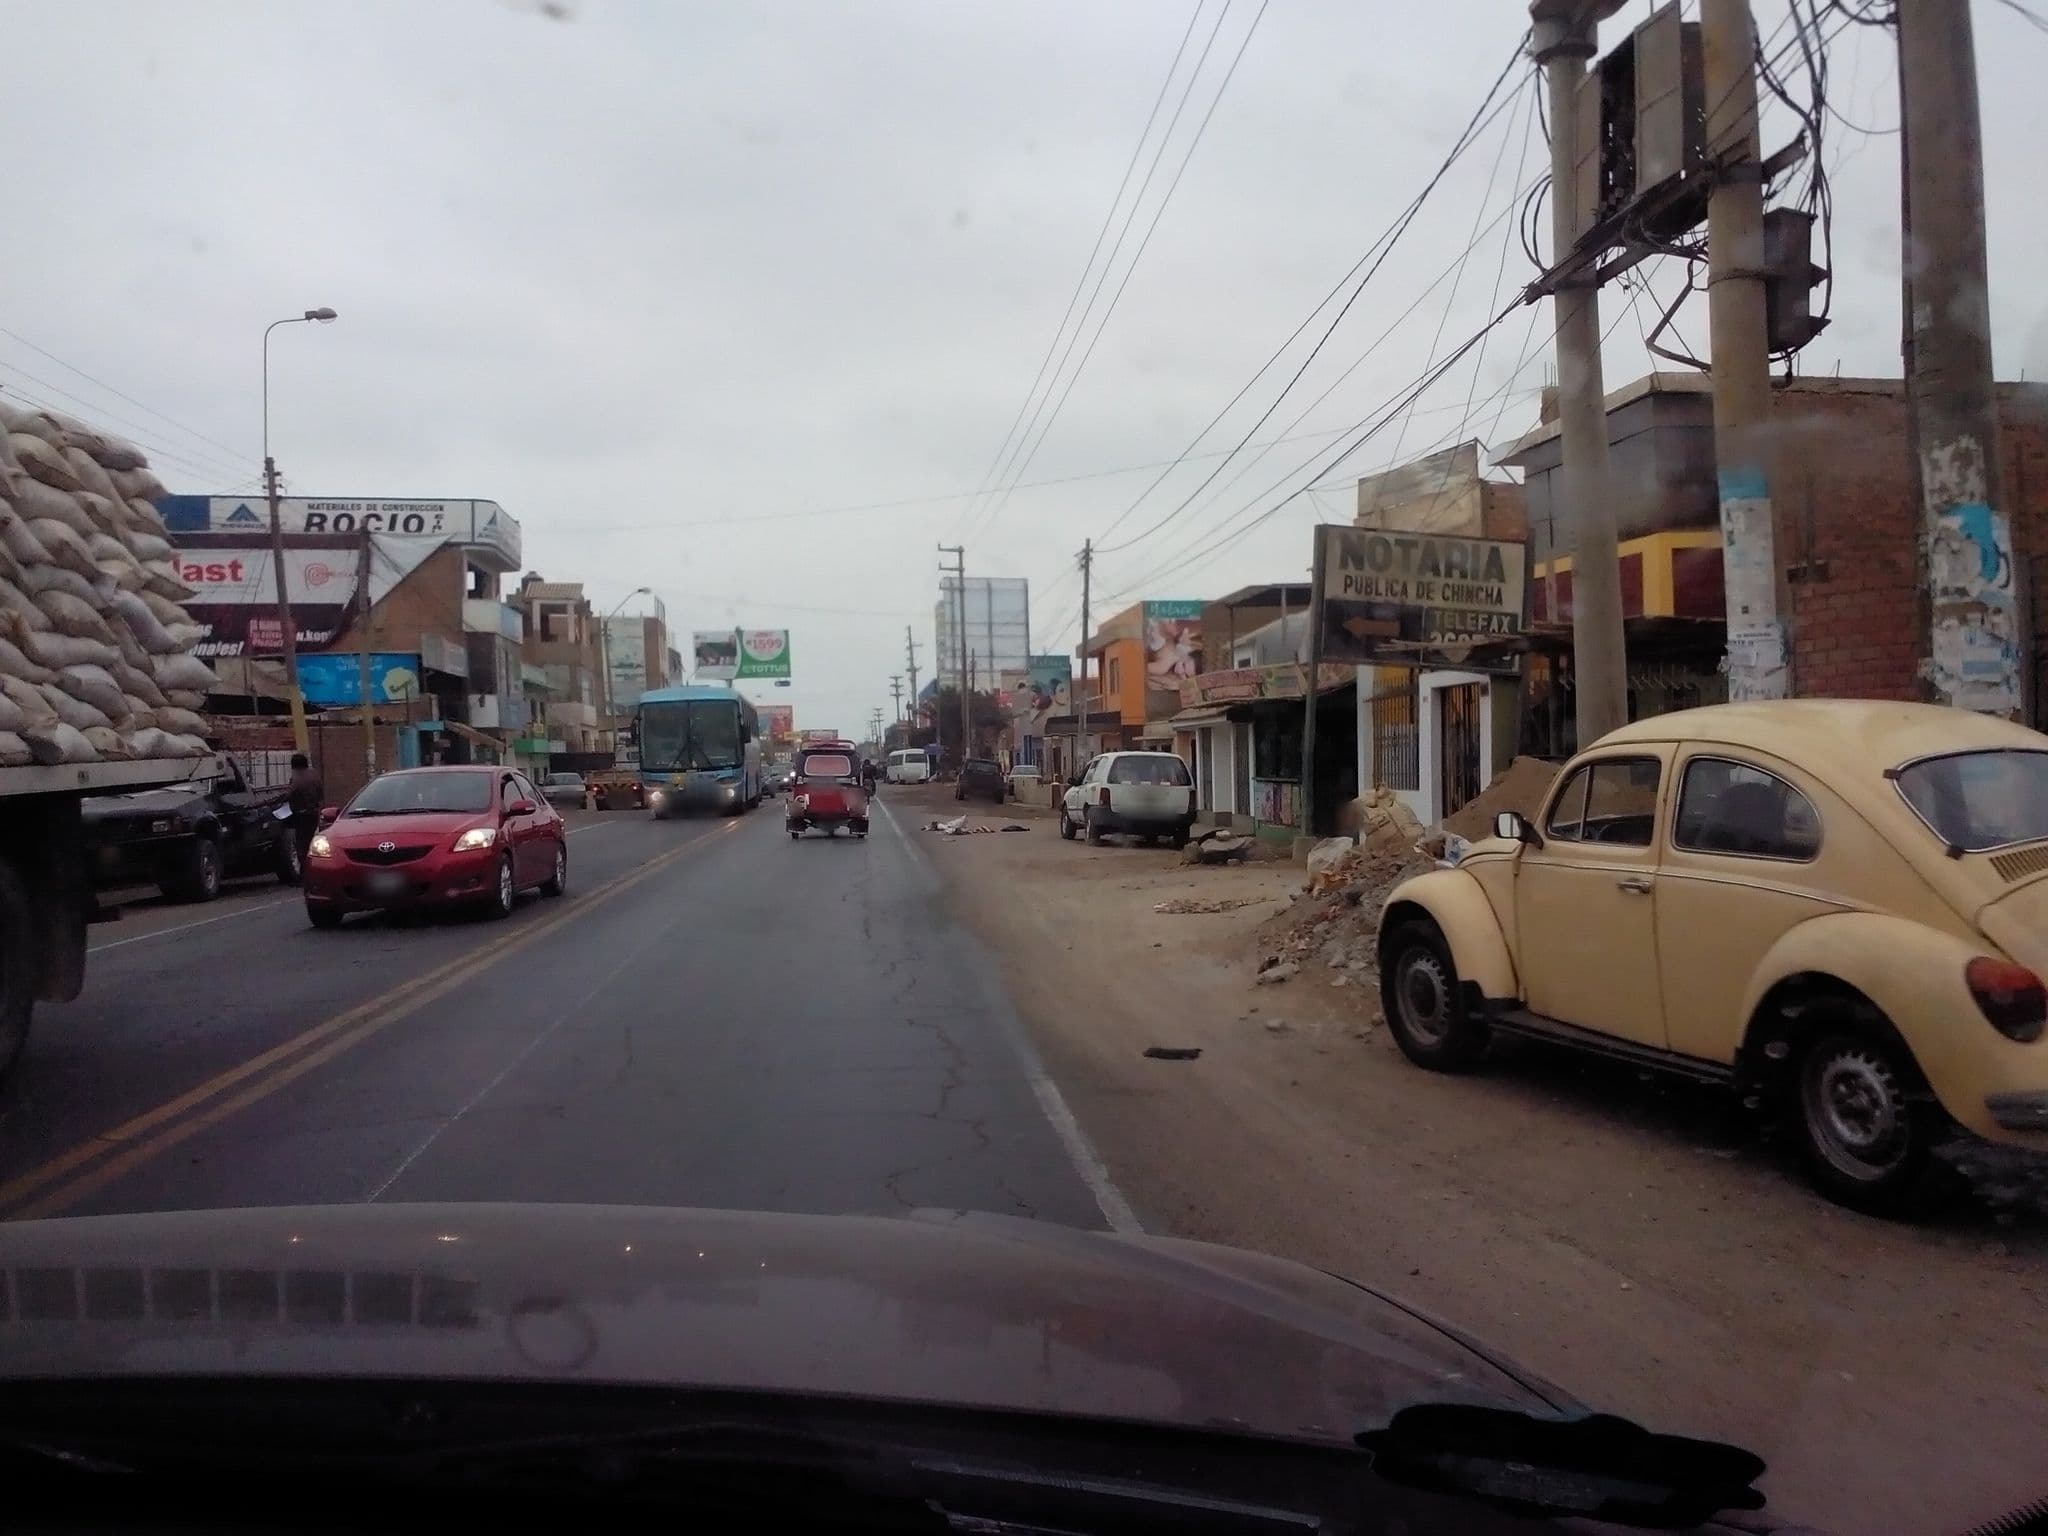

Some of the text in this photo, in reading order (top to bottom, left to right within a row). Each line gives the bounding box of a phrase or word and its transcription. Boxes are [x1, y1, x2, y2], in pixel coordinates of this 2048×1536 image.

[307, 503, 362, 512] MATERIALES
[366, 503, 378, 512] DE
[304, 512, 425, 533] ROCIO
[172, 557, 243, 582] last
[1337, 533, 1506, 583] NOTARIA
[1343, 575, 1504, 606] PUBLICA DE CHINCHA
[1434, 610, 1511, 633] TELEFAX
